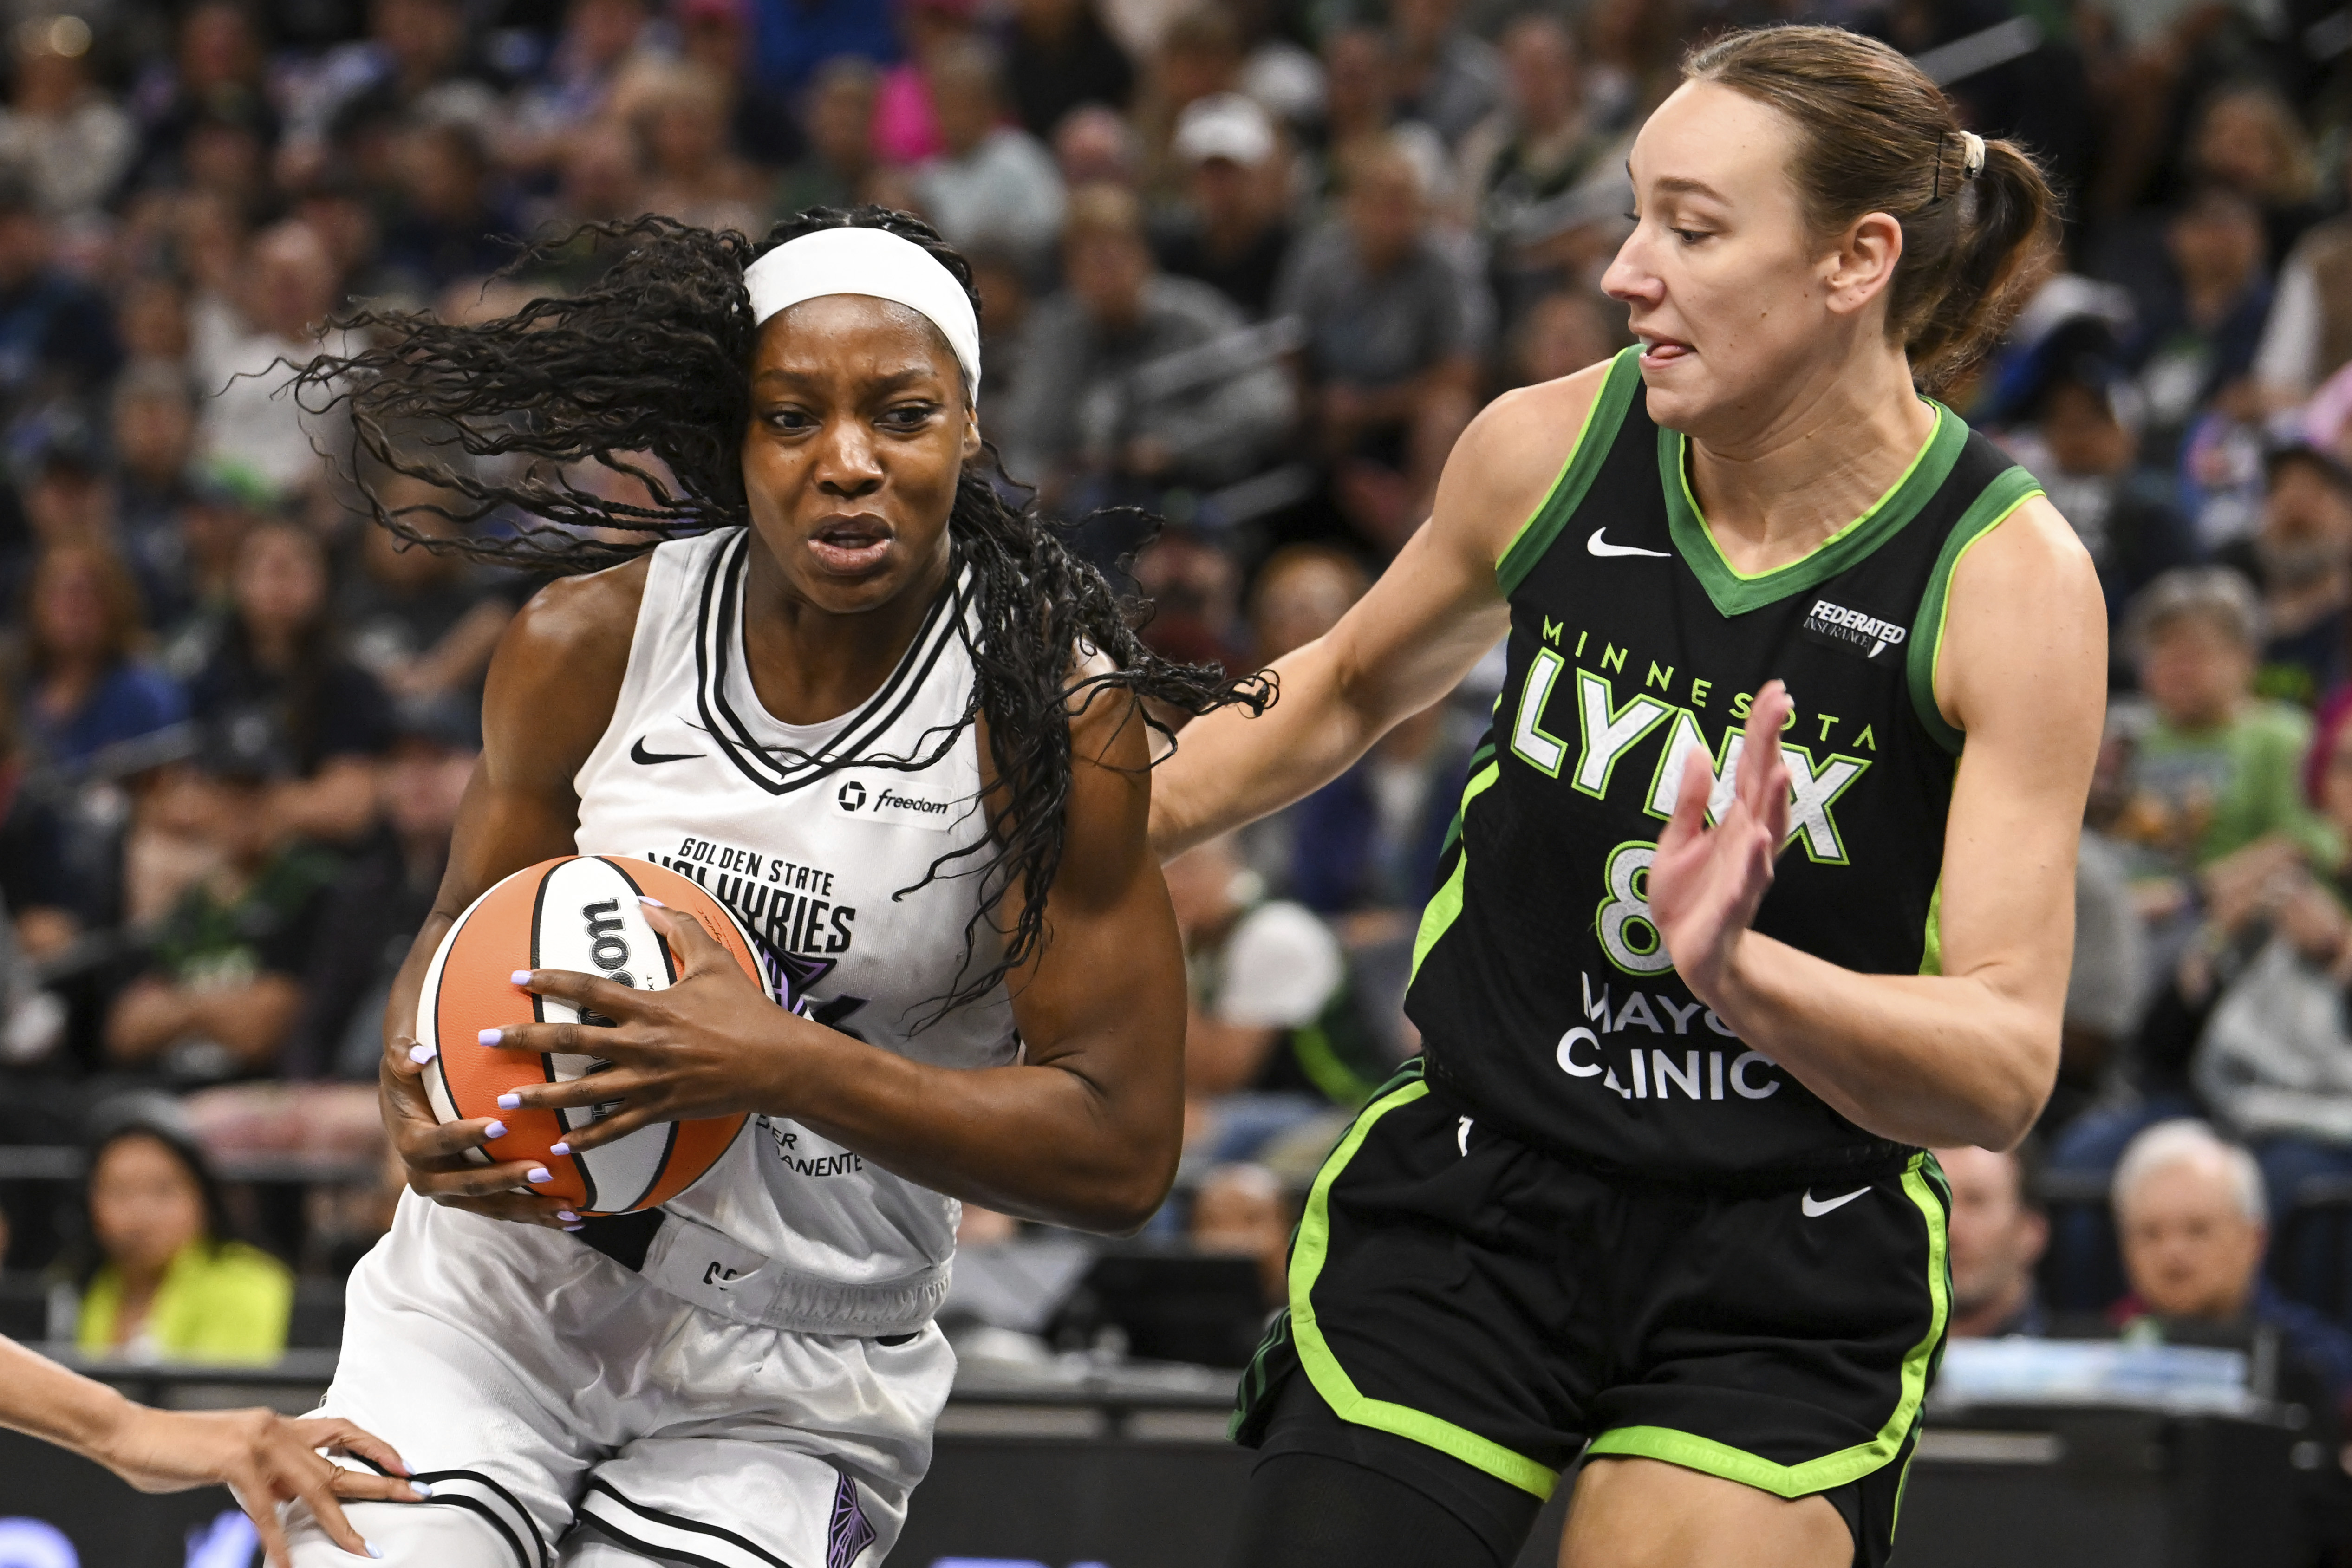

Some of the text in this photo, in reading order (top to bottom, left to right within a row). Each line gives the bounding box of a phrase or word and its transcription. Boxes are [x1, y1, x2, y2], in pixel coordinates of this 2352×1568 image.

[1810, 600, 1907, 644] FEDERATED
[1510, 647, 1872, 865] LYNX
[873, 789, 949, 814] freedom
[678, 838, 834, 897] GOLDEN STATE
[1596, 840, 1674, 976] 8
[776, 1144, 862, 1177] ANENTE
